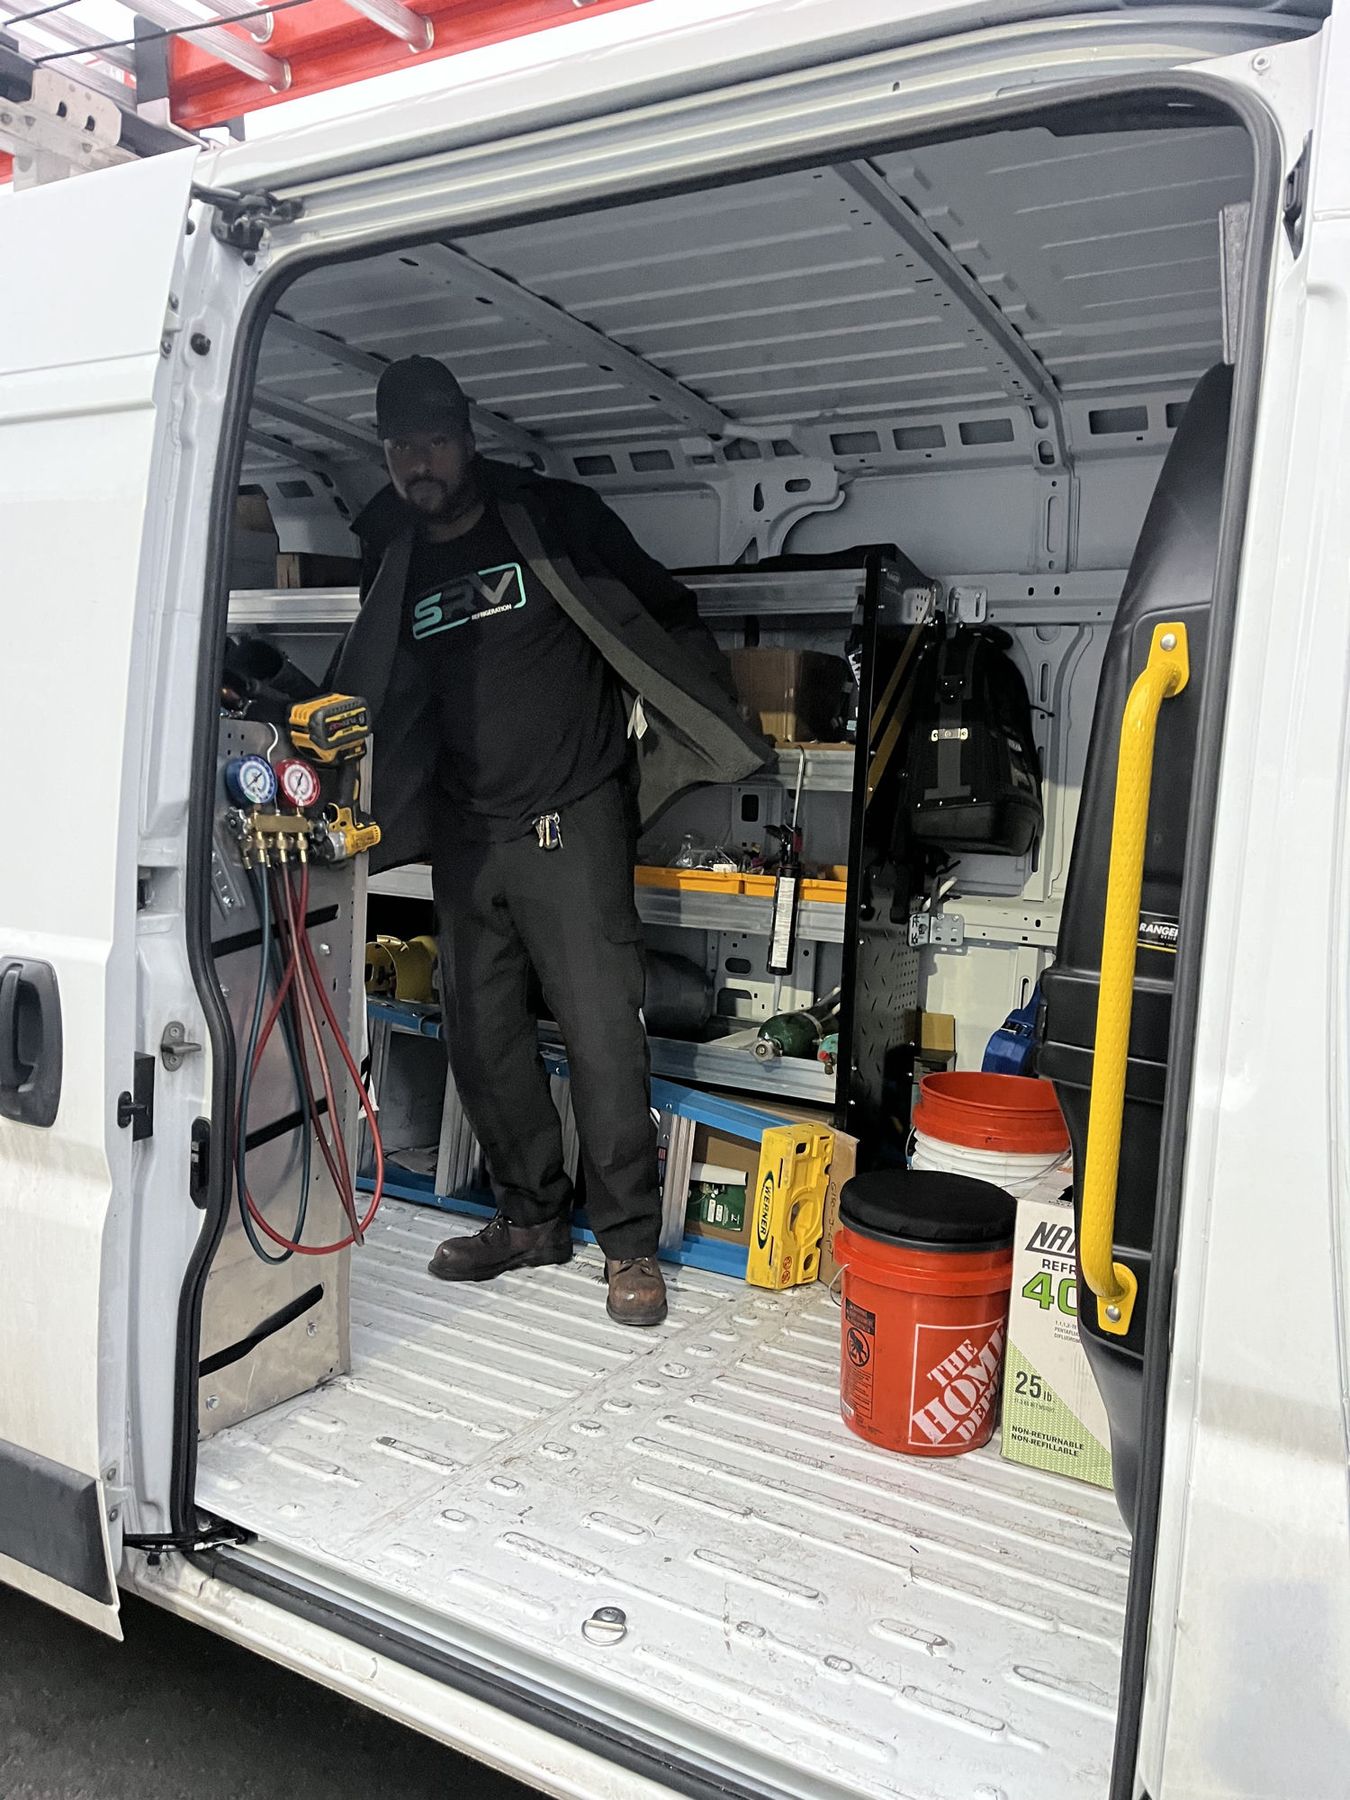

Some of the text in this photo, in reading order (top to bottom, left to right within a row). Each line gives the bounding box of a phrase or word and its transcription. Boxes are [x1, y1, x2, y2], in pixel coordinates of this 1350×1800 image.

[760, 1184, 772, 1237] WERNER
[926, 1338, 978, 1388] THE
[1015, 1371, 1053, 1402] 25 lb
[1011, 1425, 1084, 1450] NON-RETURNABLE
[1011, 1433, 1079, 1456] NON-REFILLABLE
